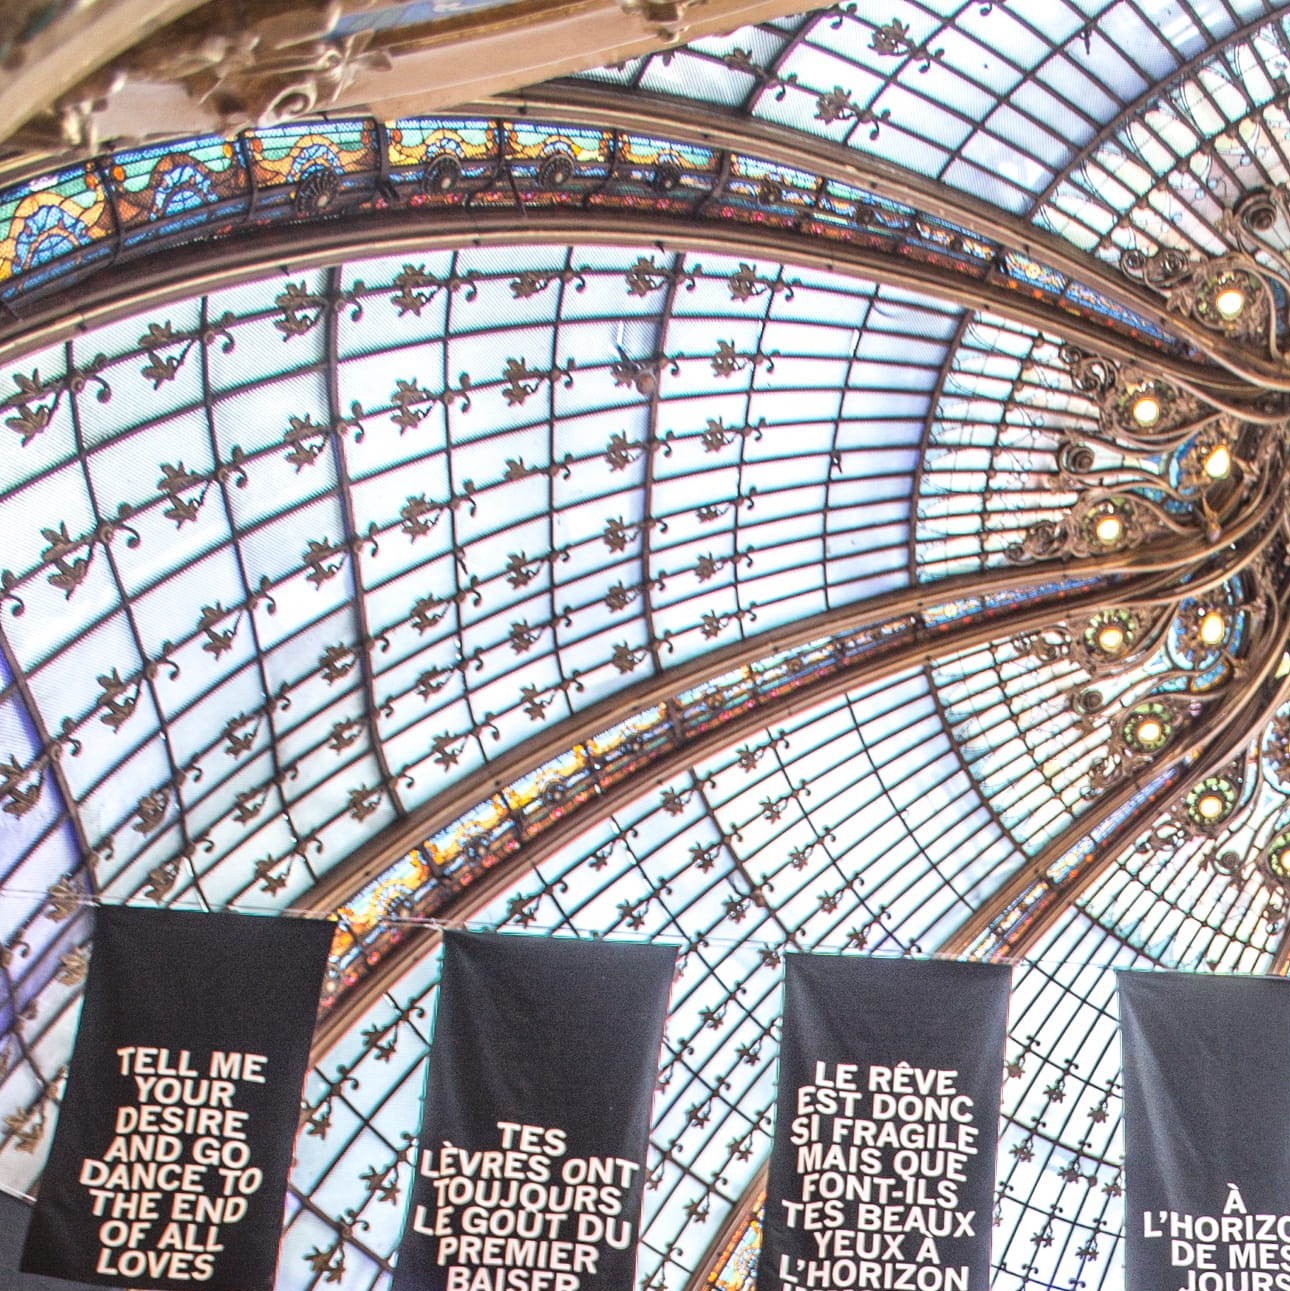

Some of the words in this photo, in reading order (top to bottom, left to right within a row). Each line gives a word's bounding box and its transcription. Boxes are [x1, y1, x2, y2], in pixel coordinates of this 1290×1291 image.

[118, 1047, 198, 1077] TELL
[210, 1052, 267, 1083] ME
[135, 1076, 235, 1108] YOUR
[116, 1105, 249, 1140] DESIRE
[104, 1135, 182, 1166] AND
[193, 1137, 250, 1169] GO
[80, 1159, 207, 1192] DANCE
[219, 1168, 262, 1196] TO
[90, 1189, 158, 1219] THE
[172, 1193, 247, 1224] END
[1223, 1183, 1247, 1214] À
[100, 1221, 147, 1248] OF
[158, 1223, 224, 1252] ALL
[97, 1248, 214, 1280] LOVES
[1172, 1240, 1221, 1269] DE
